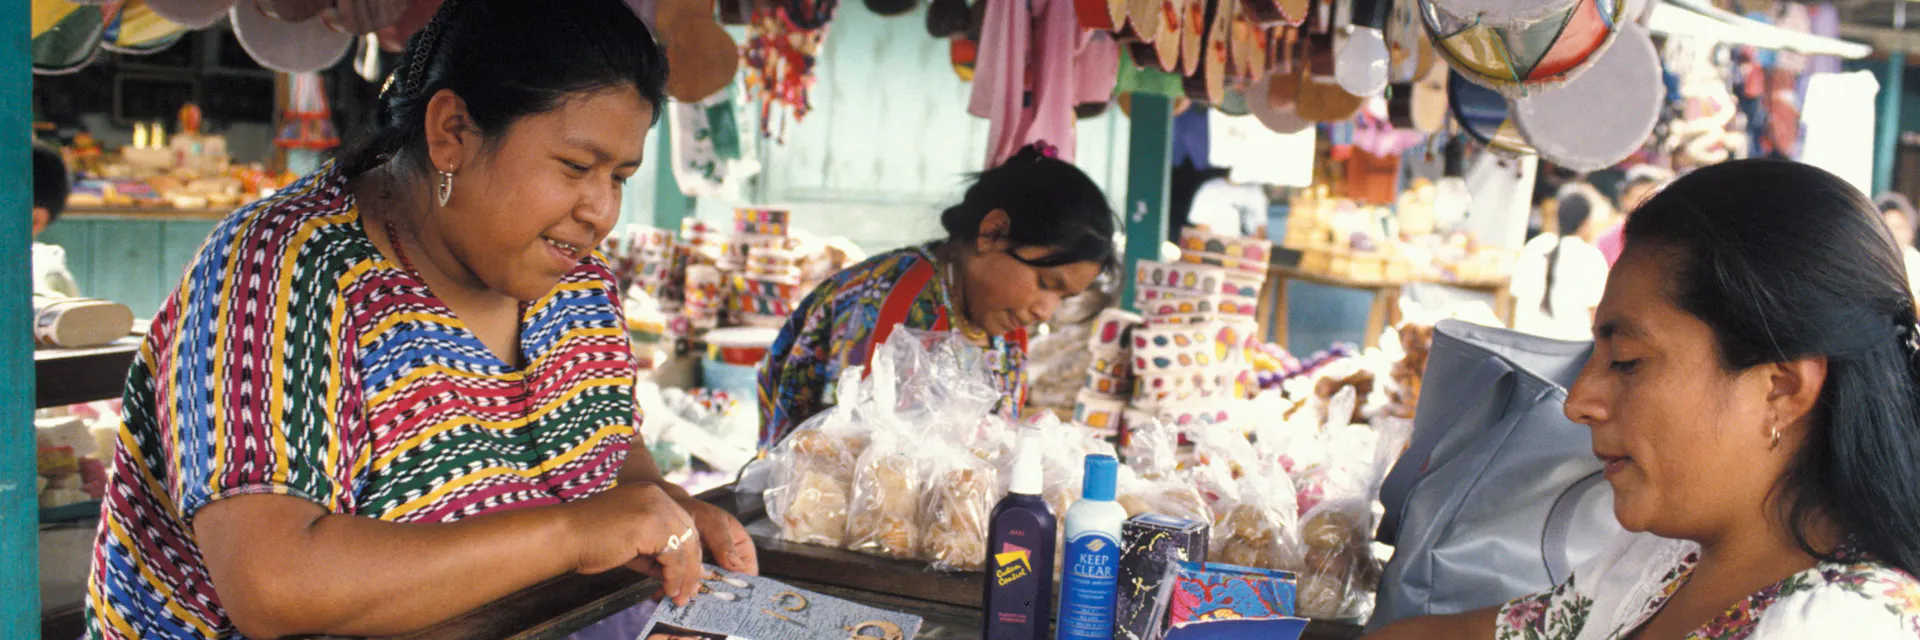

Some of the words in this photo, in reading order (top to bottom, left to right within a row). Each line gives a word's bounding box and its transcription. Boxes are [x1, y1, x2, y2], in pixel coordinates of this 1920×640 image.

[1079, 553, 1109, 565] KEEP
[1073, 564, 1112, 576] CLEAR
[998, 568, 1027, 586] Control
